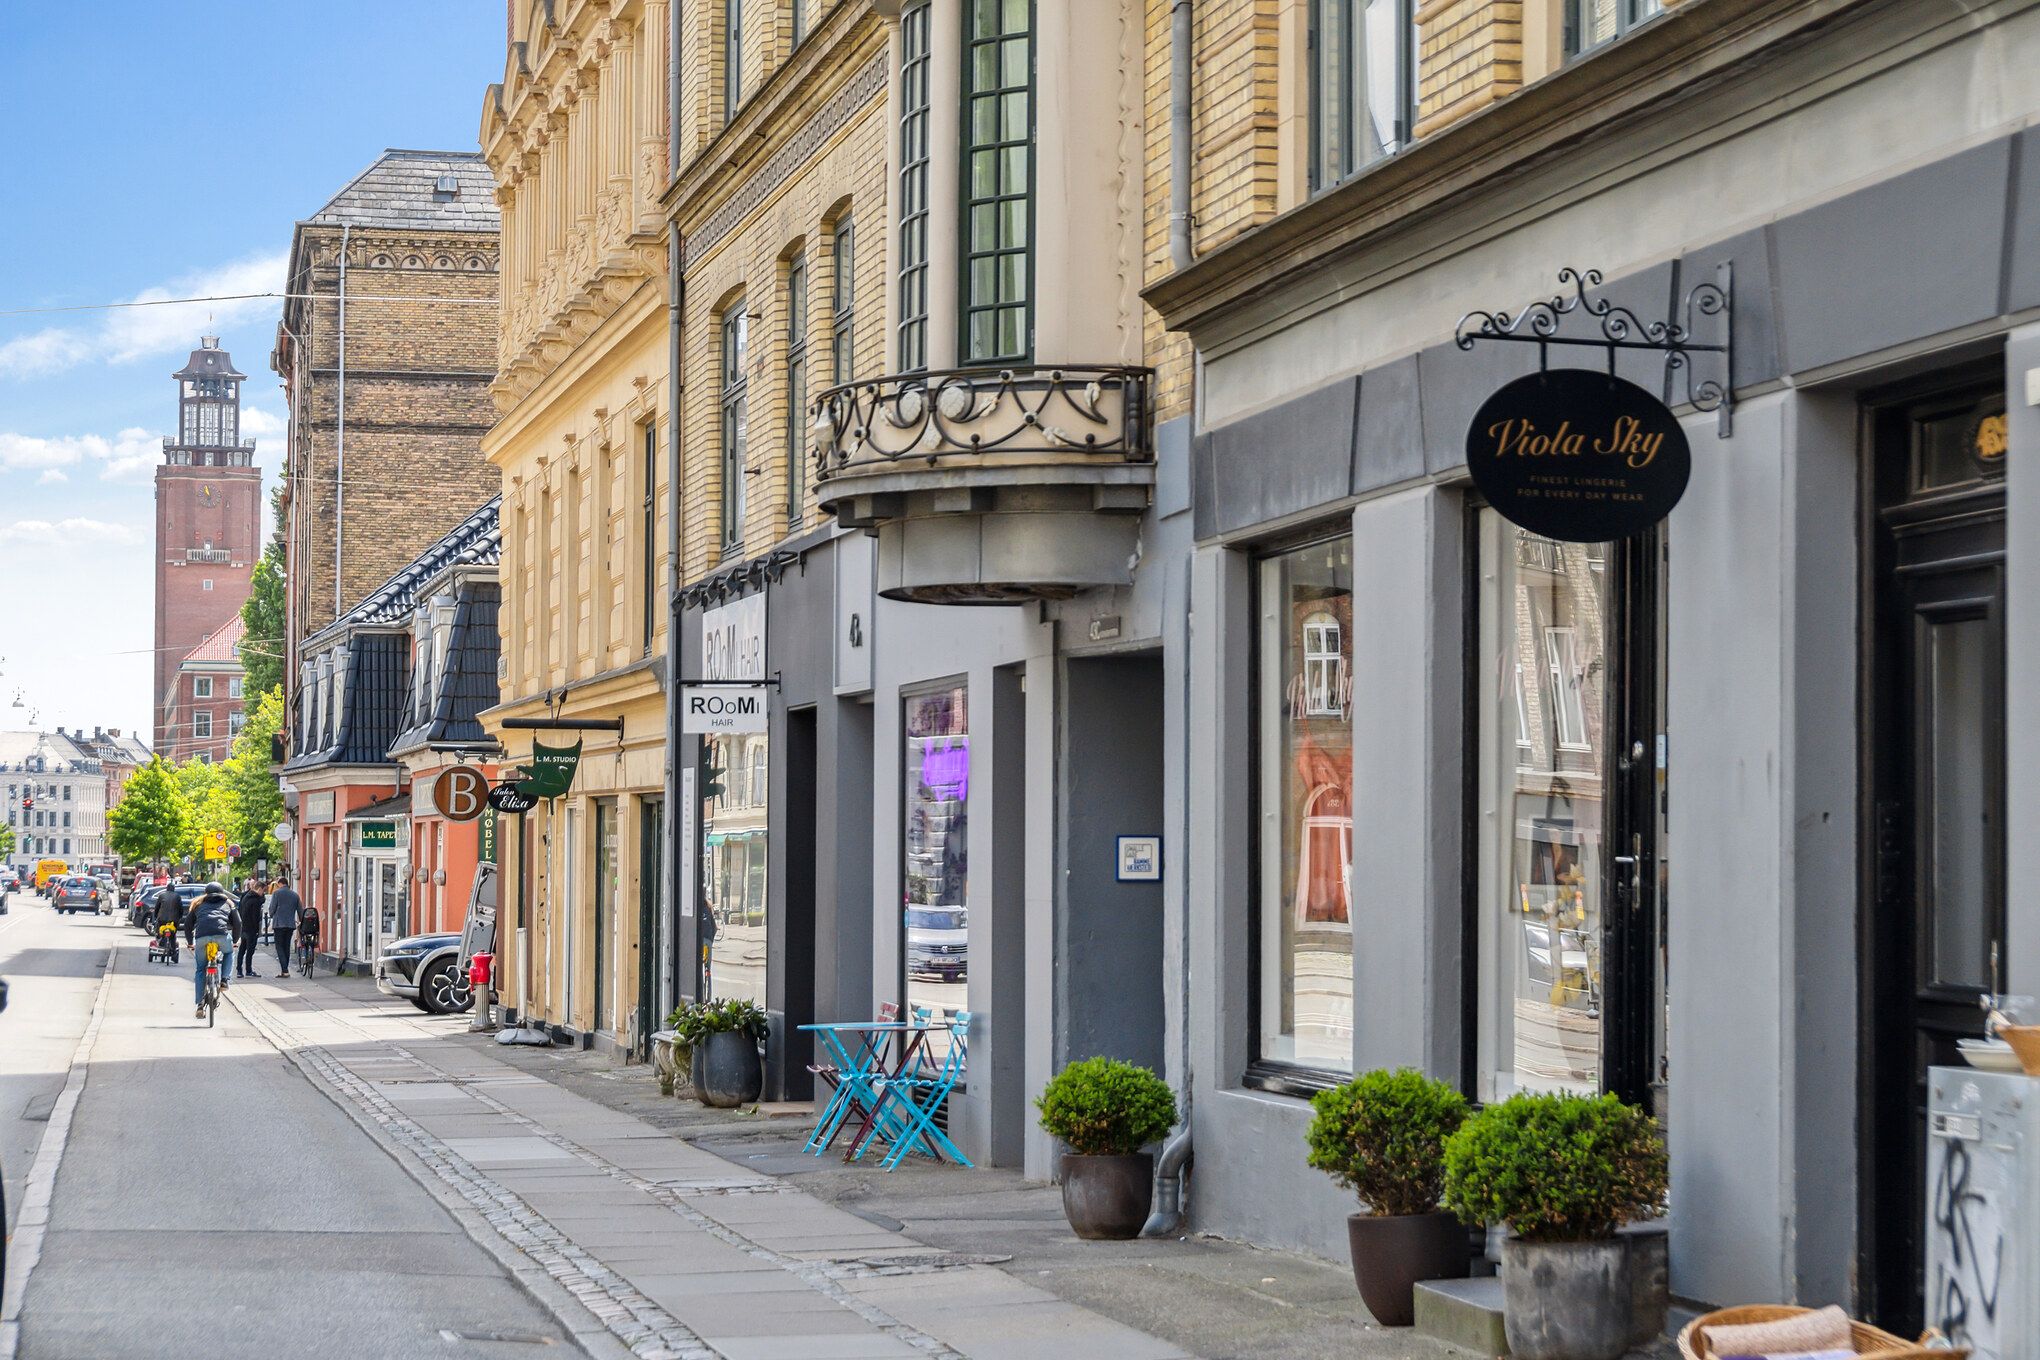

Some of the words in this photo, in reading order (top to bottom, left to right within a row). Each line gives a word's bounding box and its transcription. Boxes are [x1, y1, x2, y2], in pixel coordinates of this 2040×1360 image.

[1488, 418, 1586, 457] Viola
[1593, 415, 1665, 468] Sky
[1517, 488, 1540, 497] FOR
[1545, 489, 1580, 499] EVERY
[1585, 490, 1607, 500] DAY
[1612, 492, 1644, 501] WEAR
[1529, 474, 1569, 485] FINEST
[1574, 476, 1627, 488] LINGERIE
[711, 718, 734, 727] HAIR
[450, 772, 477, 815] B
[484, 808, 494, 863] MØBEL
